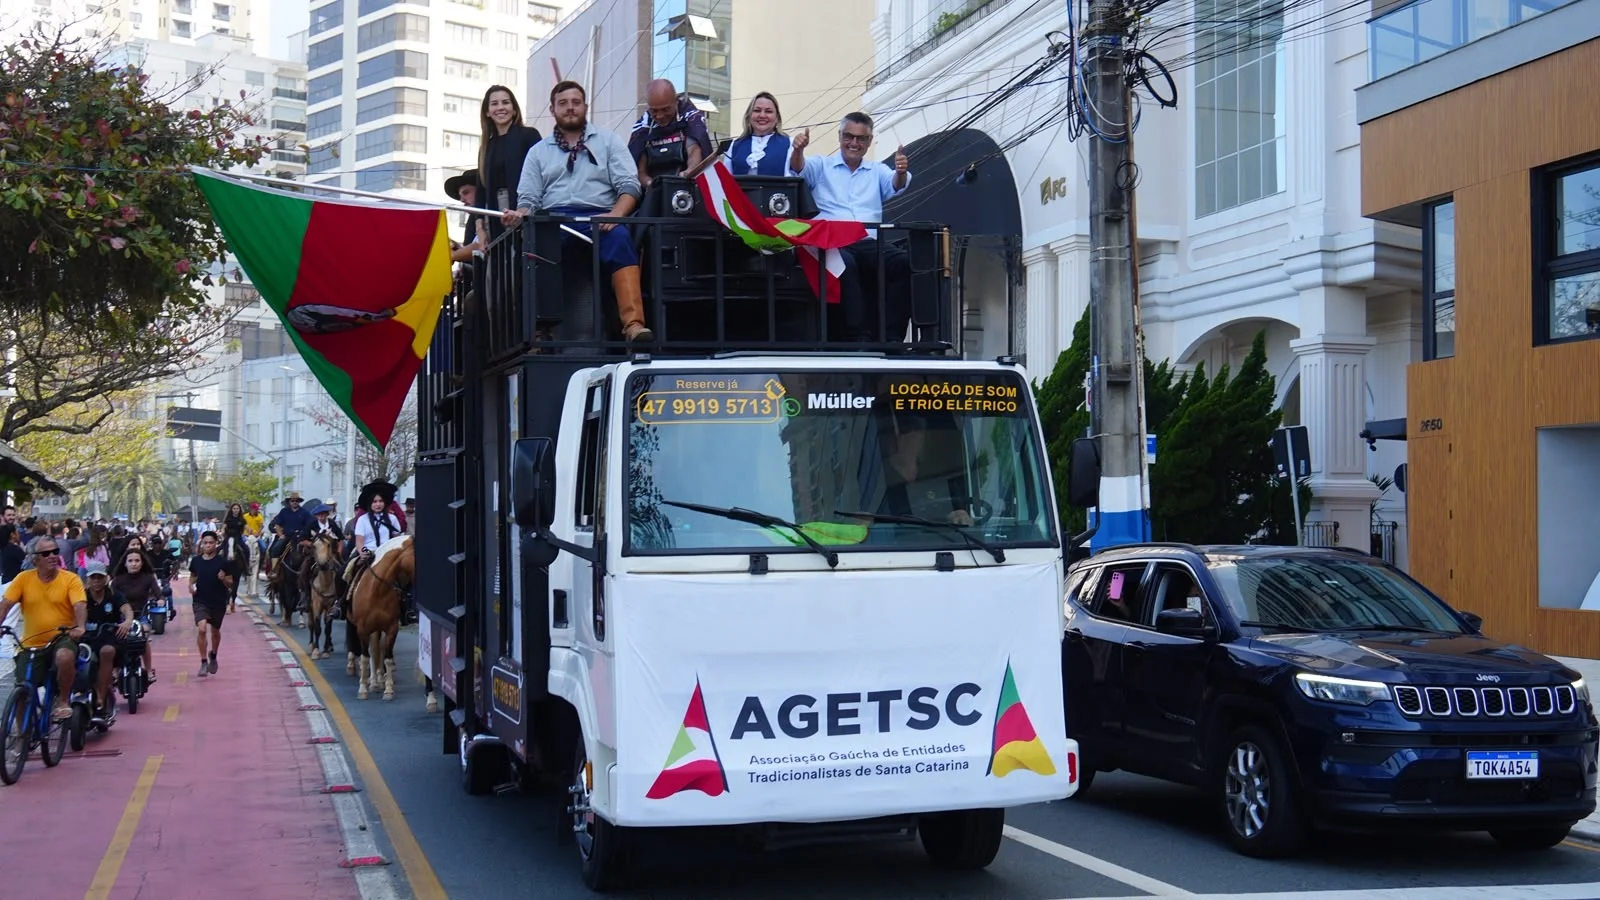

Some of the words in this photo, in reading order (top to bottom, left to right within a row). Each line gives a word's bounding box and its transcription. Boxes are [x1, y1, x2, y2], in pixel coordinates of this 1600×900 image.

[676, 380, 725, 389] Reserve
[727, 380, 738, 390] já
[890, 382, 961, 397] LOCAÇÃO
[965, 385, 983, 396] DE
[987, 385, 1017, 398] SOM
[643, 399, 666, 415] 47
[672, 398, 719, 415] 9919
[726, 398, 772, 415] 5713
[808, 393, 875, 409] Müller
[895, 400, 905, 410] E
[908, 399, 943, 411] TRIO
[946, 397, 1017, 412] ELÉTRICO
[1476, 673, 1500, 683] Jeep
[730, 682, 983, 740] AGETSC
[749, 754, 826, 765] Associação
[828, 749, 879, 761] Gaúcha
[882, 748, 899, 758] de
[902, 742, 966, 757] Entidades
[747, 767, 852, 783] Tradicionalistas
[855, 765, 872, 777] de
[875, 763, 911, 776] Santa
[915, 759, 970, 774] Catarina
[1474, 760, 1531, 776] TQK4A54
